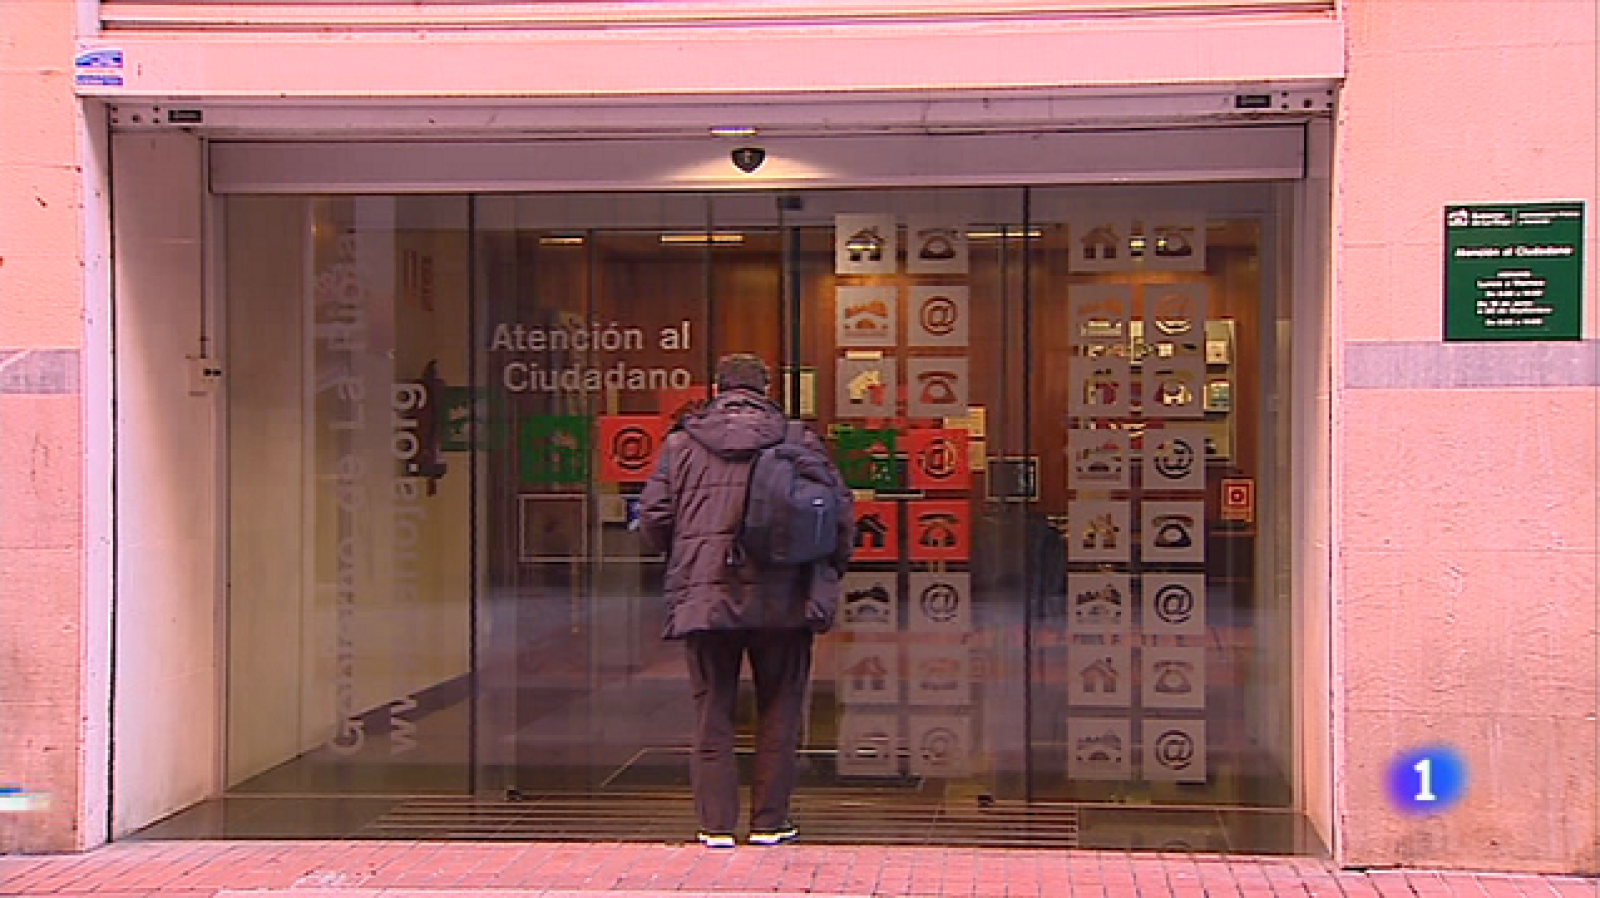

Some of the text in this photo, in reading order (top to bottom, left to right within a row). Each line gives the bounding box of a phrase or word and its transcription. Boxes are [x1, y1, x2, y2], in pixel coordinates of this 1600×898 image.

[491, 320, 691, 350] Atención al
[503, 361, 691, 391] Ciudadano
[331, 376, 365, 430] La
